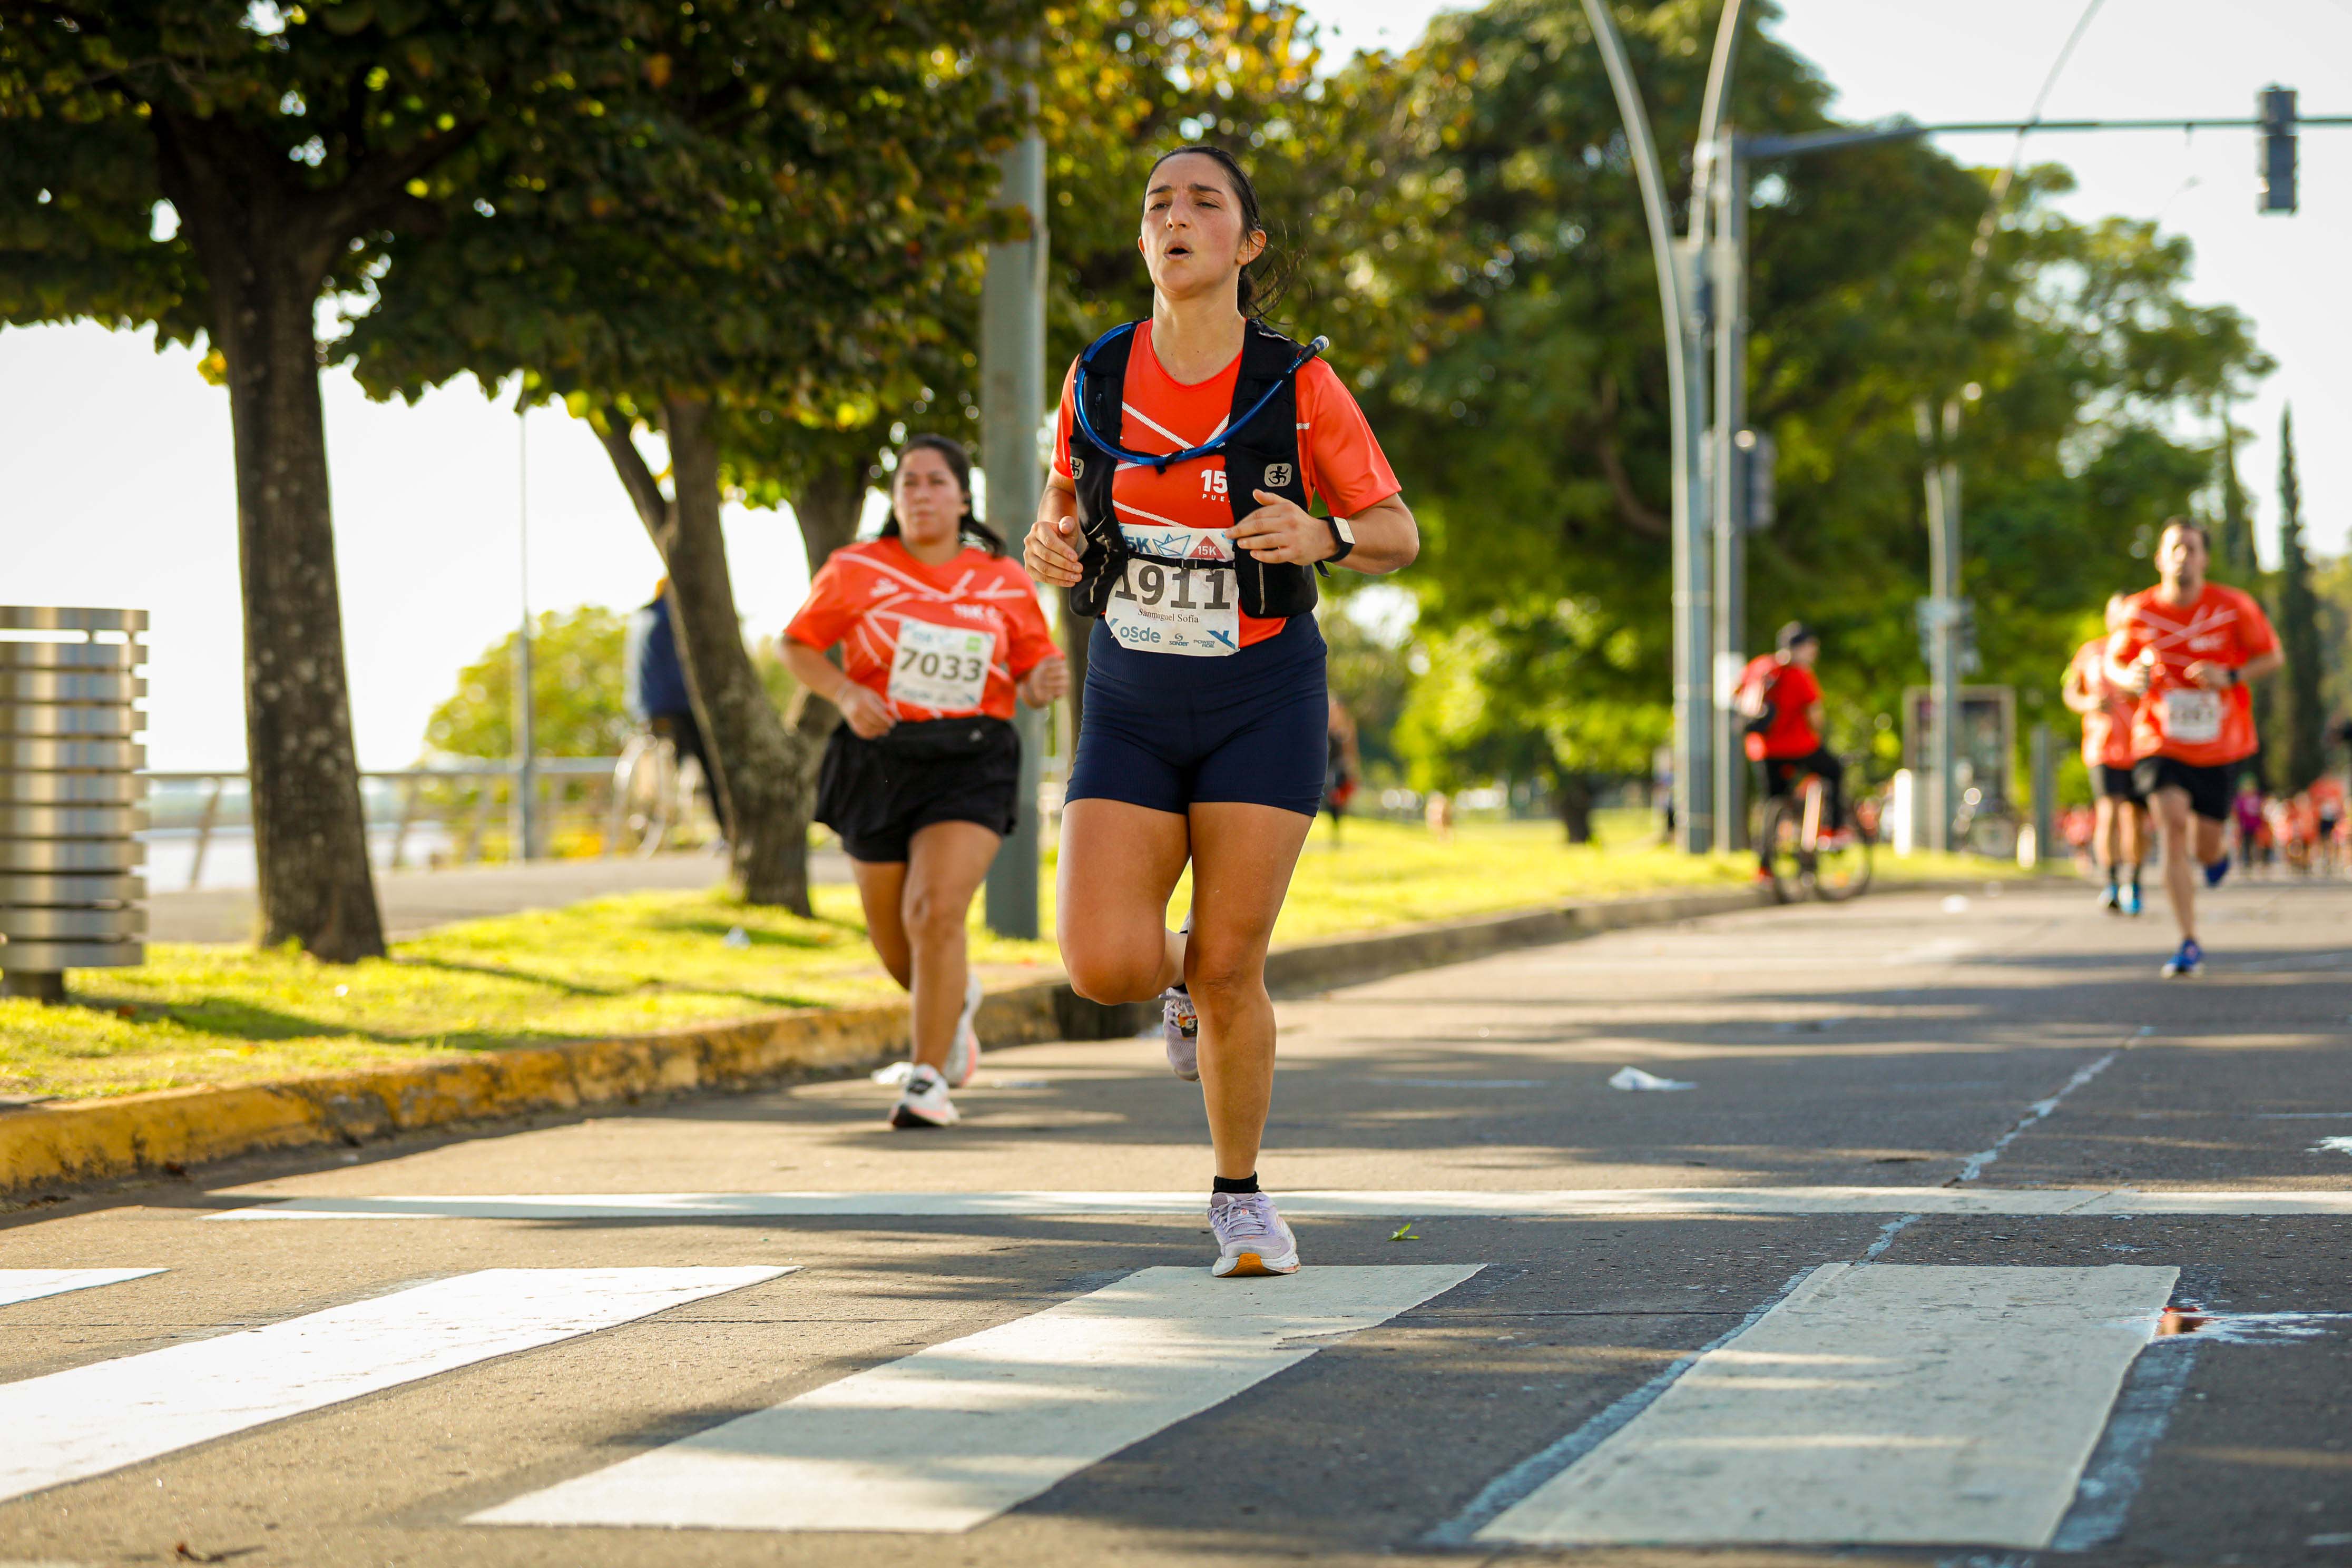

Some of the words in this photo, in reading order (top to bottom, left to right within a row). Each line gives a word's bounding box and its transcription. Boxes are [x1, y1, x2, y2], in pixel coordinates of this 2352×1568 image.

[1201, 469, 1228, 494] 15
[1202, 493, 1230, 503] PUE
[1197, 545, 1217, 556] 15K
[1114, 565, 1231, 610] 1911
[1138, 608, 1174, 622] Sanmiguel
[1120, 626, 1161, 643] osde
[899, 647, 983, 682] 7033
